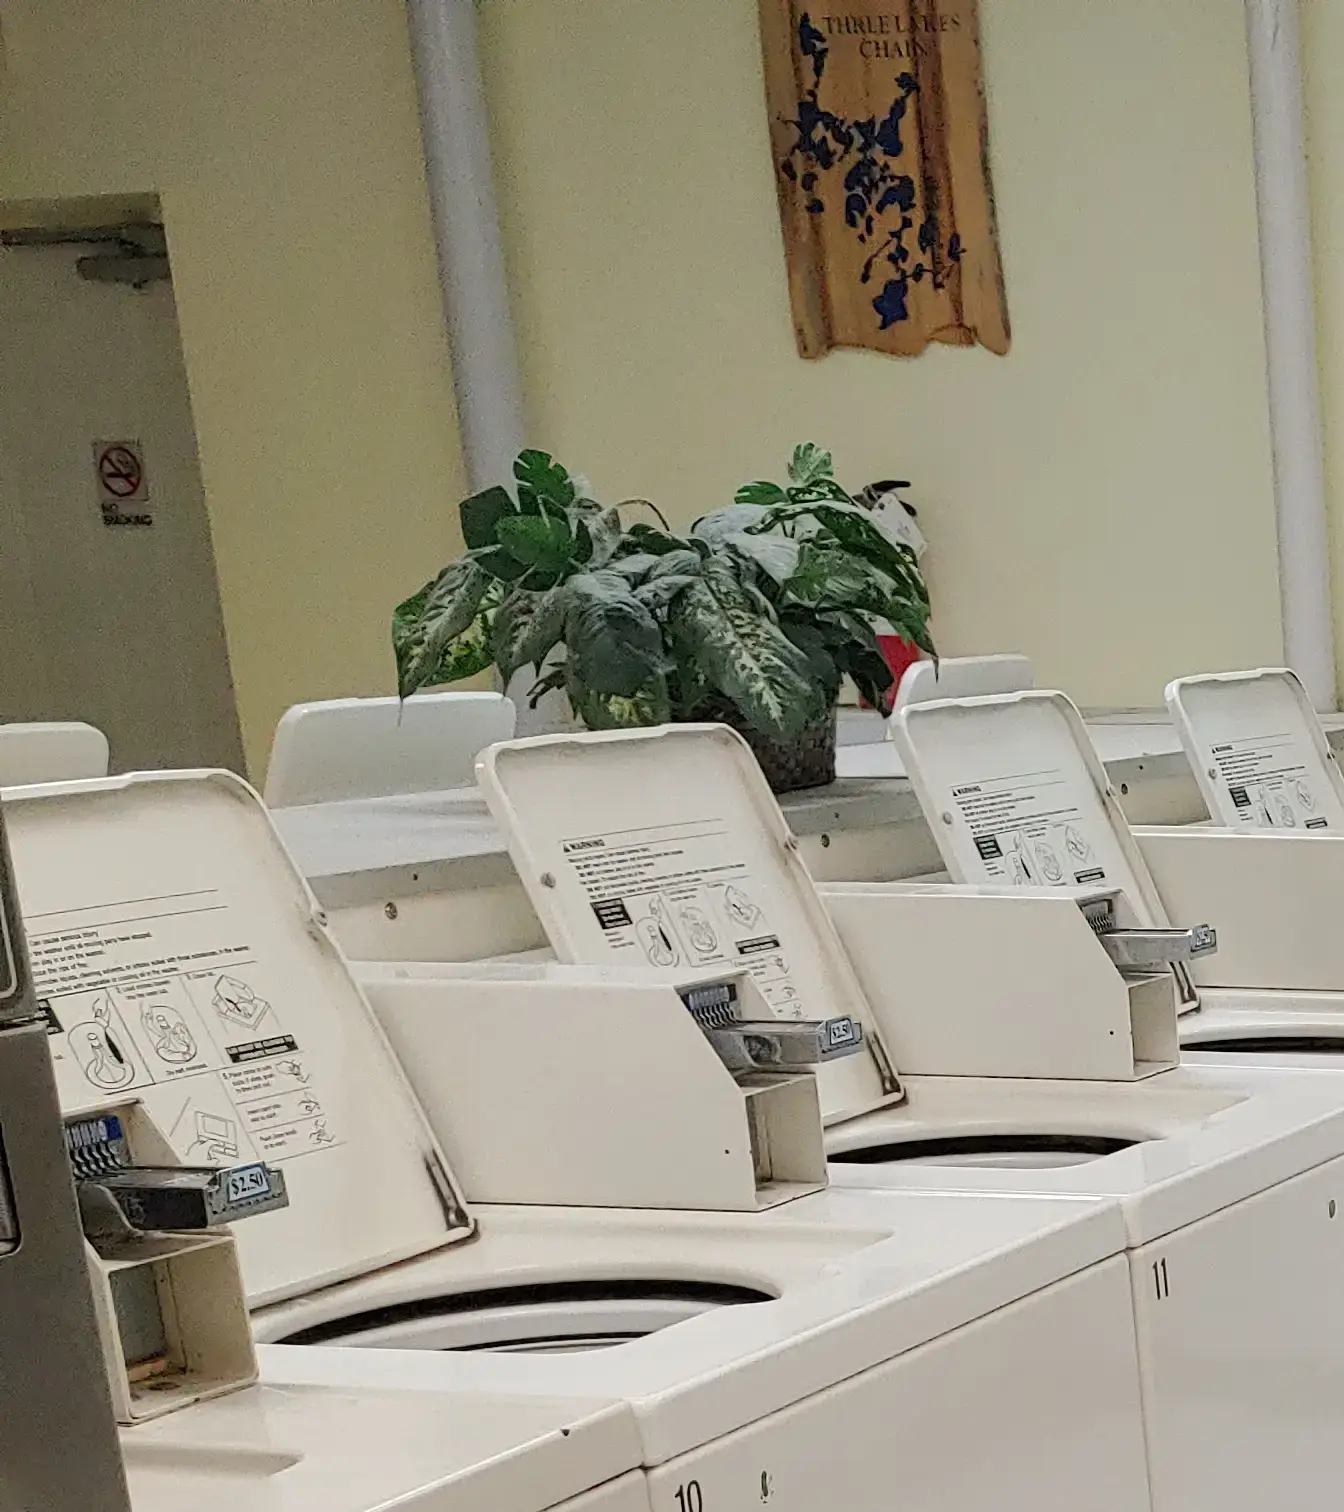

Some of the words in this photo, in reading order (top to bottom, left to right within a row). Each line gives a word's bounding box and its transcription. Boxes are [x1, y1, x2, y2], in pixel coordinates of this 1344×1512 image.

[822, 15, 890, 35] THREE
[859, 38, 929, 59] CHAIN
[231, 1171, 264, 1196] $2.50
[1152, 1257, 1169, 1300] 11
